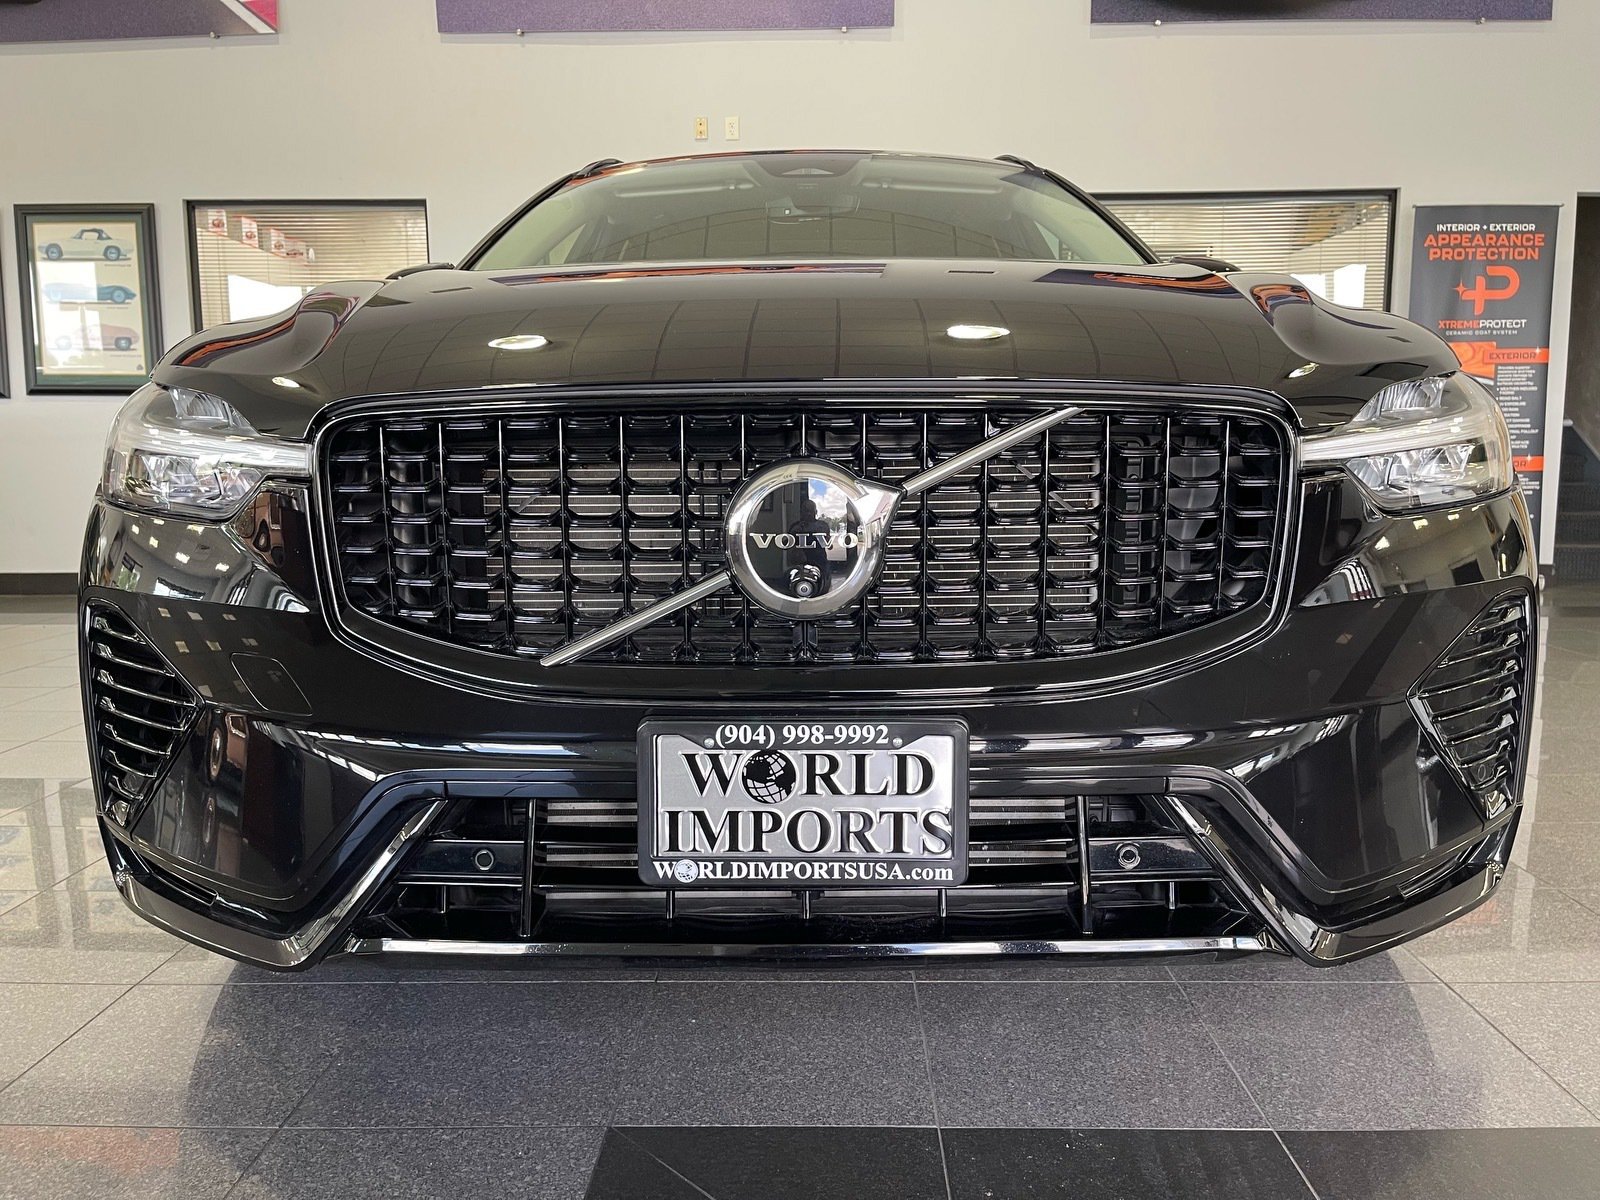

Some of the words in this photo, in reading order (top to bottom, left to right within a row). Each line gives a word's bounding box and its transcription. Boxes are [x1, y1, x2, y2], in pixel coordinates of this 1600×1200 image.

[1436, 223, 1480, 232] INTERIOR
[1489, 223, 1536, 232] EXTERIOR
[1423, 233, 1545, 247] APPEARANCE
[1428, 248, 1539, 261] PROTECTION
[1488, 351, 1537, 360] EXTERIOR
[749, 532, 858, 549] VOLVO
[715, 725, 776, 749] (904)
[782, 724, 889, 745] 998-9992
[680, 750, 935, 804] WORLD
[662, 808, 953, 854] IMPORTS
[653, 859, 954, 884] WORLDIMPORTSUSA.com
